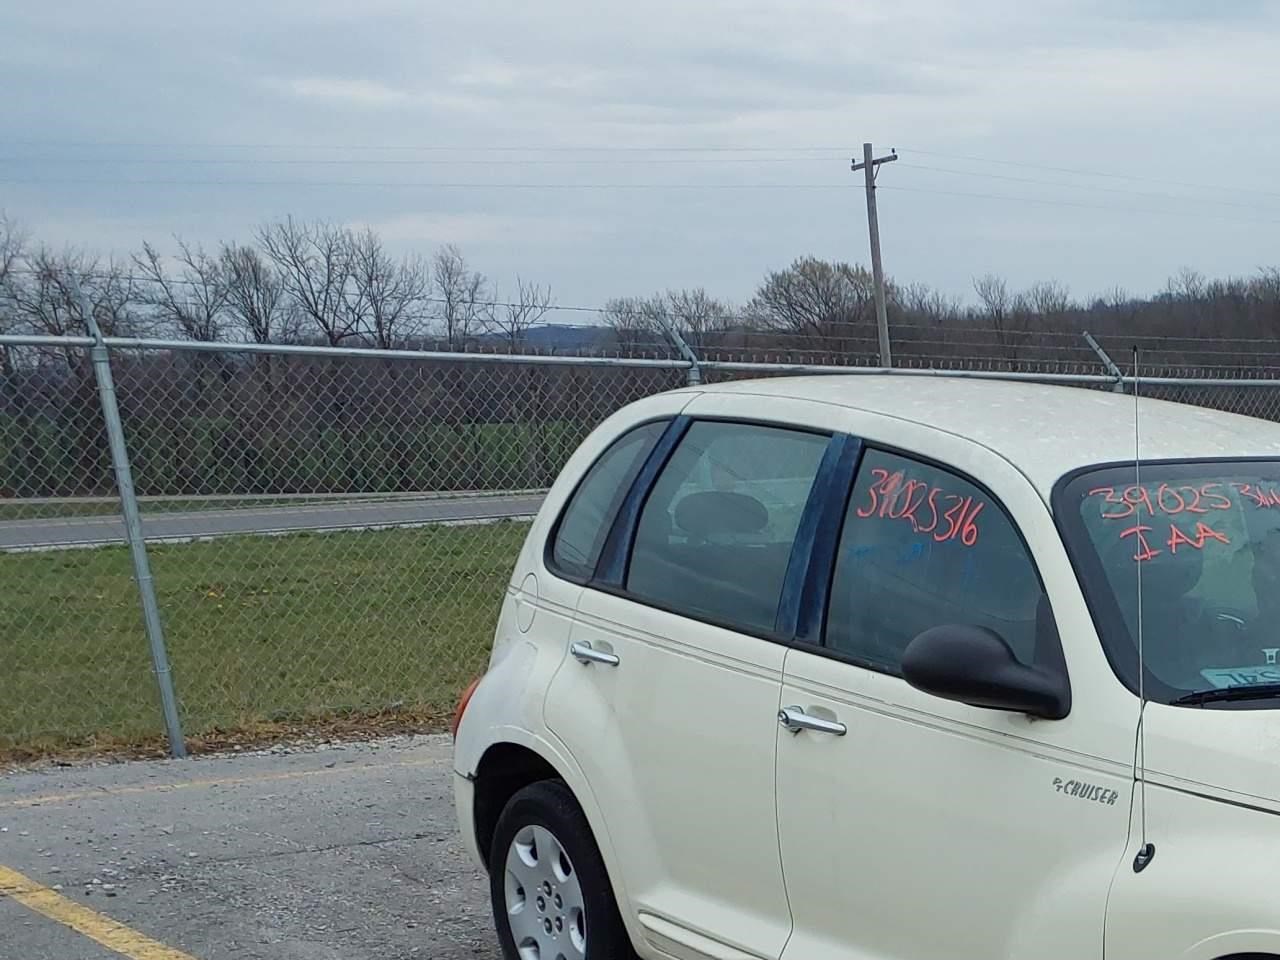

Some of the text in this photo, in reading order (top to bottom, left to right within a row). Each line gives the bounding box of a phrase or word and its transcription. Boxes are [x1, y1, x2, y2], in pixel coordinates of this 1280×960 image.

[856, 469, 985, 546] 39025316
[1119, 521, 1232, 561] IAA
[1063, 780, 1119, 806] CRUISER
